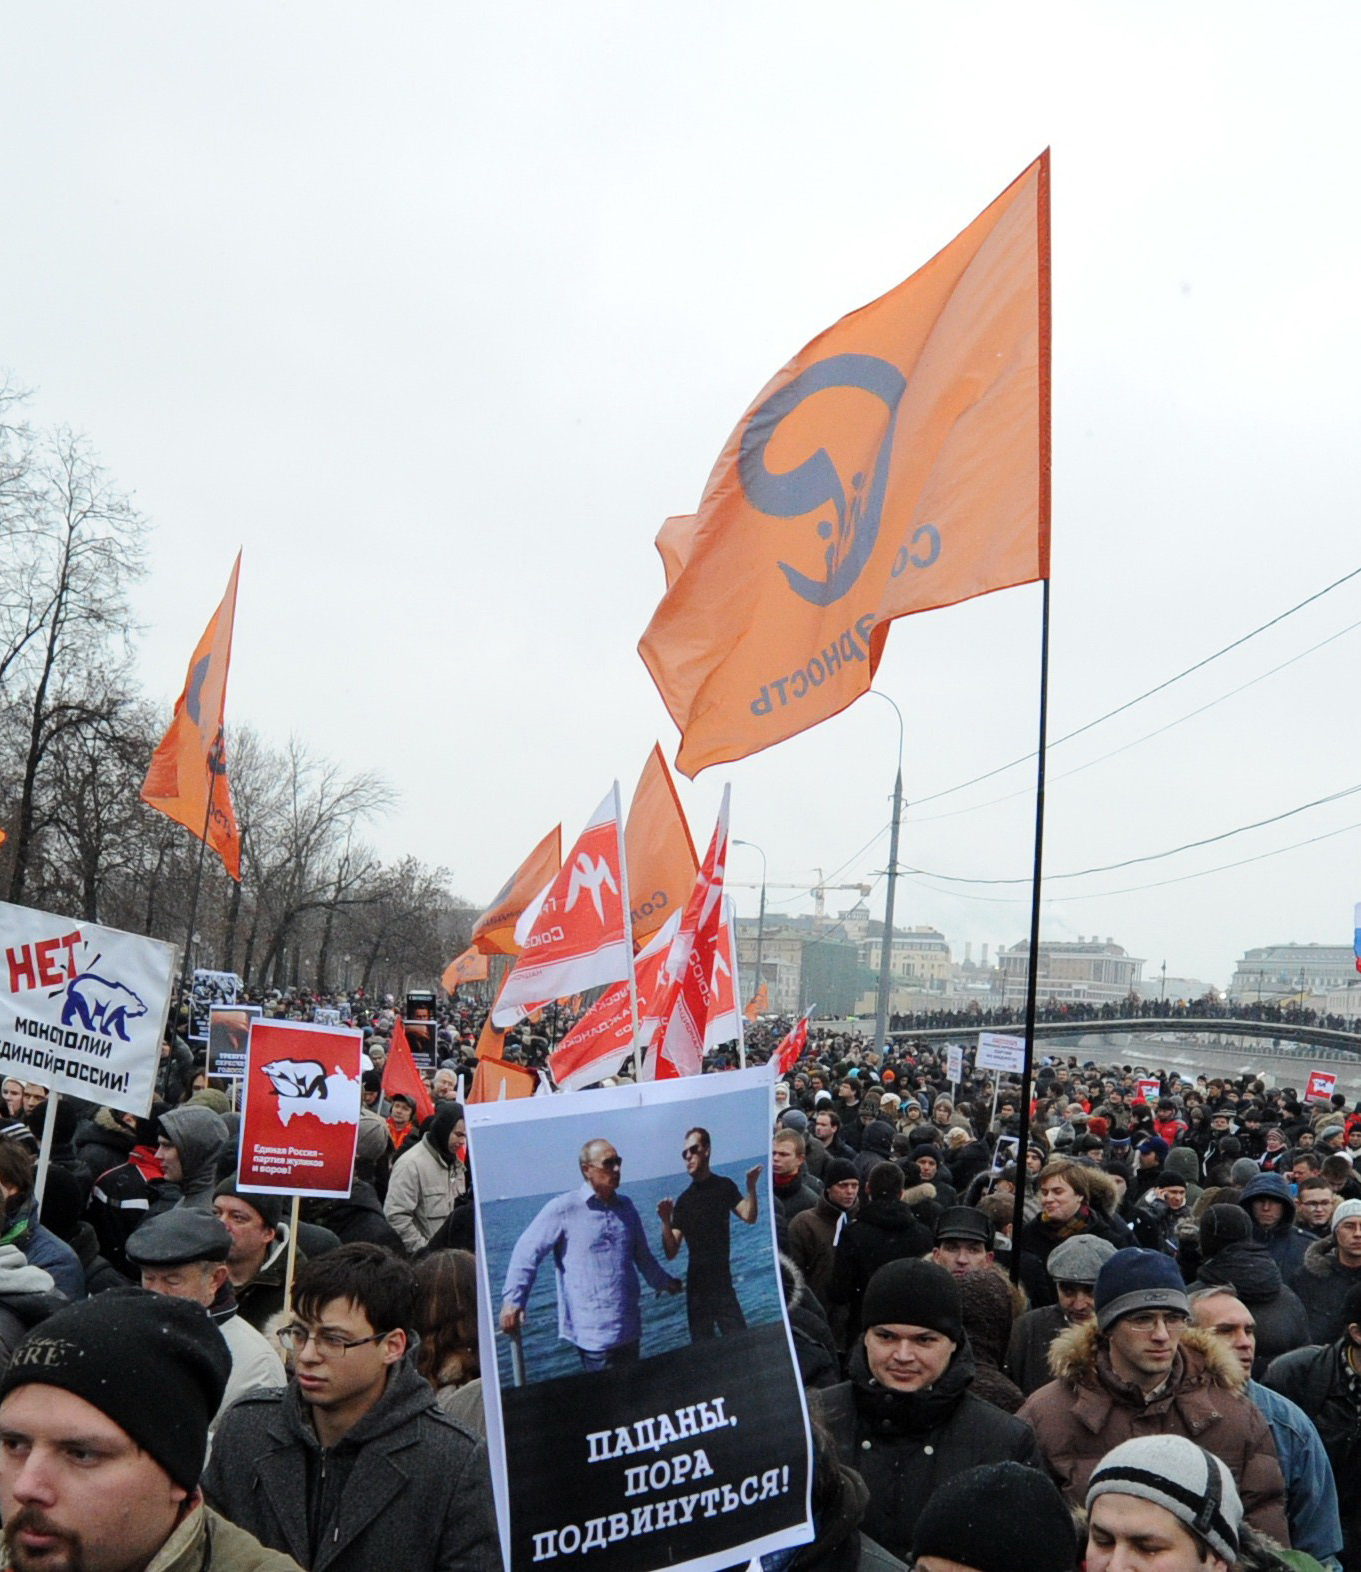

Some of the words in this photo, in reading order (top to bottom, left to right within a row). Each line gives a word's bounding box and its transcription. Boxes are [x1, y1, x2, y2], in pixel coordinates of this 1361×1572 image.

[5, 930, 82, 993] НЕТ
[586, 1397, 738, 1463] ПАЦАНЫ,
[624, 1449, 714, 1497] ПОРА
[532, 1465, 789, 1562] ПОДВИНУТЬСЯ!
